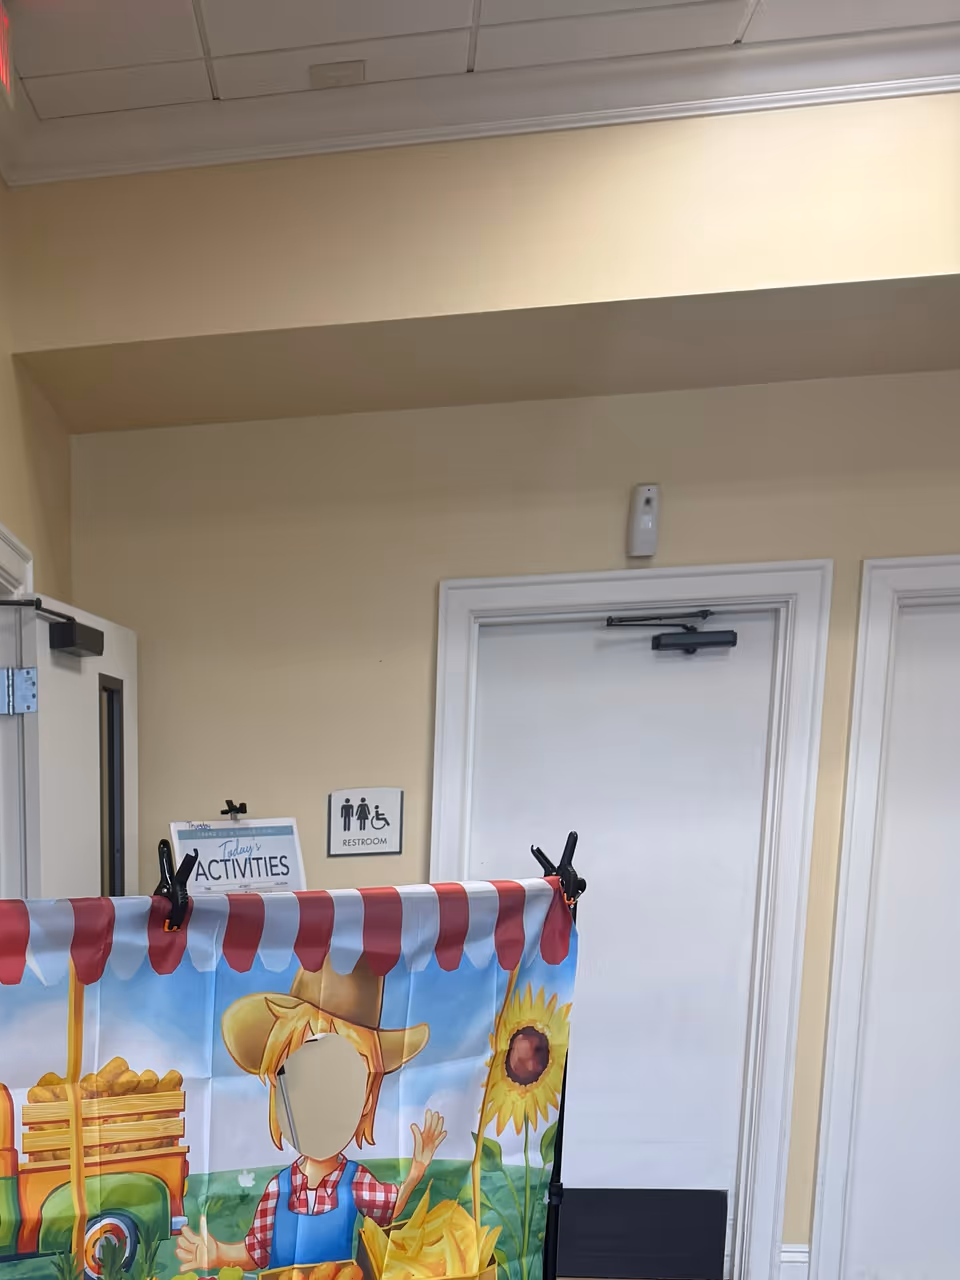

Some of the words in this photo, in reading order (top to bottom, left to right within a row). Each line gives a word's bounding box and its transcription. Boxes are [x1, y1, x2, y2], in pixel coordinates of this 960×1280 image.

[218, 838, 262, 862] Today's
[342, 837, 388, 847] RESTROOM
[194, 855, 290, 881] ACTIVITIES
